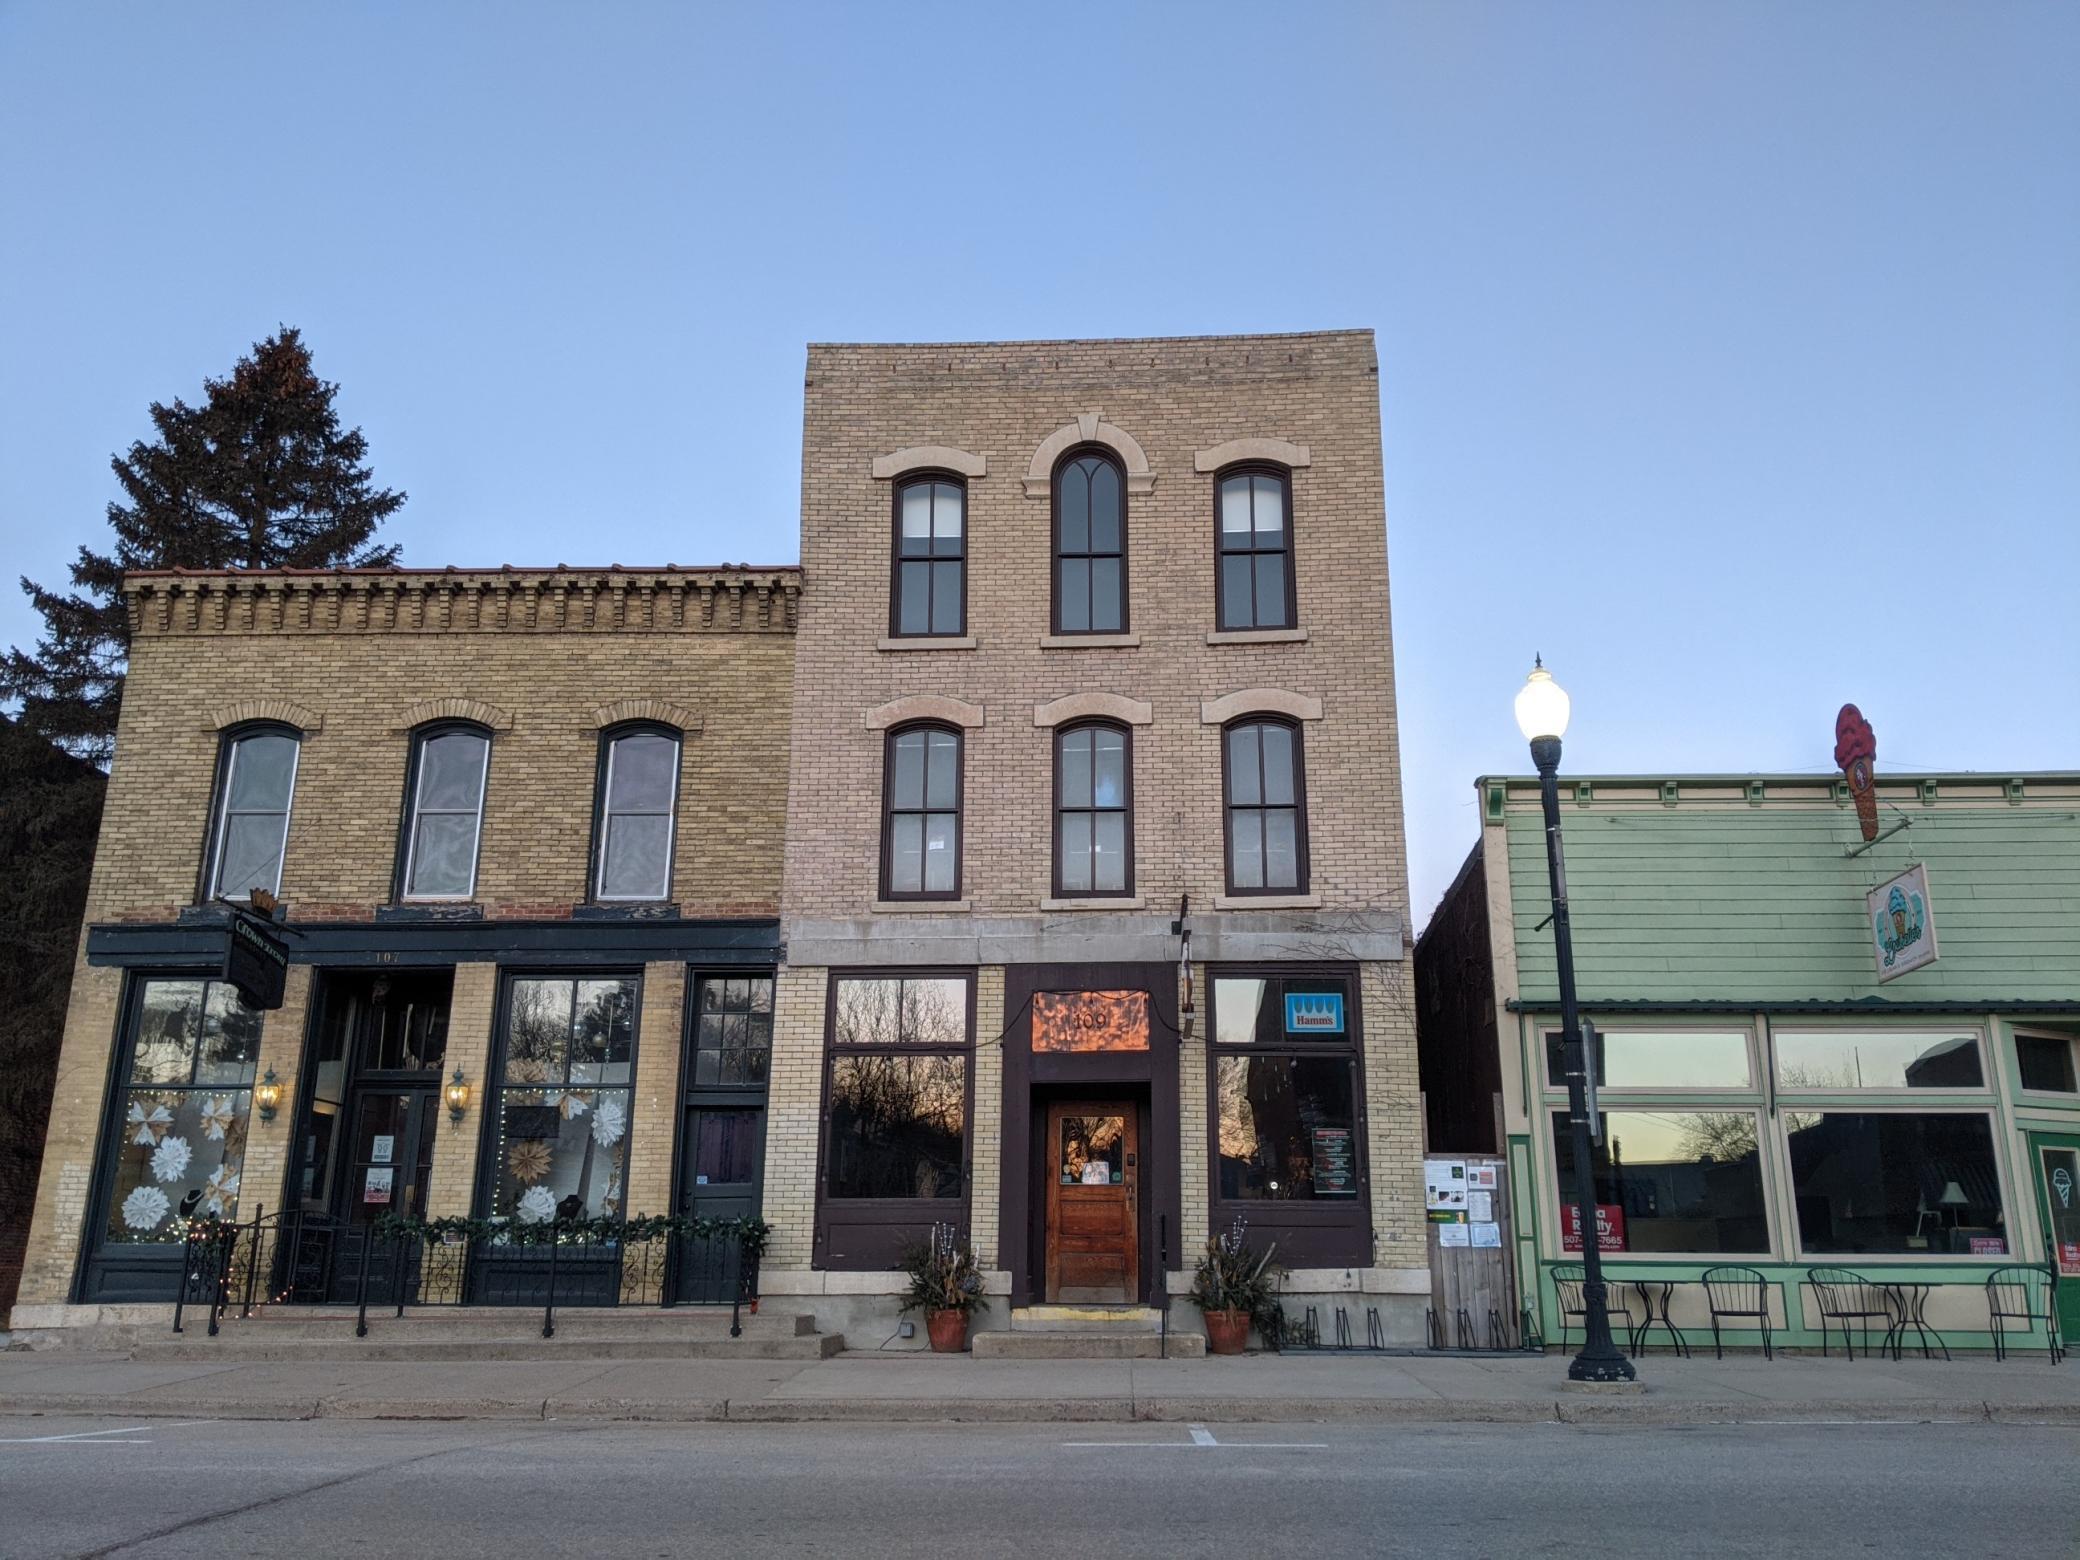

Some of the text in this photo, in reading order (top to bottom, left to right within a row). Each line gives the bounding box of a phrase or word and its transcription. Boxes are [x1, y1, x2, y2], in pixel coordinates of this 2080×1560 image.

[236, 919, 264, 949] Crown
[376, 951, 400, 963] 107
[1074, 1013, 1106, 1029] 109
[1297, 1015, 1334, 1025] Hamm's
[1572, 1219, 1612, 1235] Rlty
